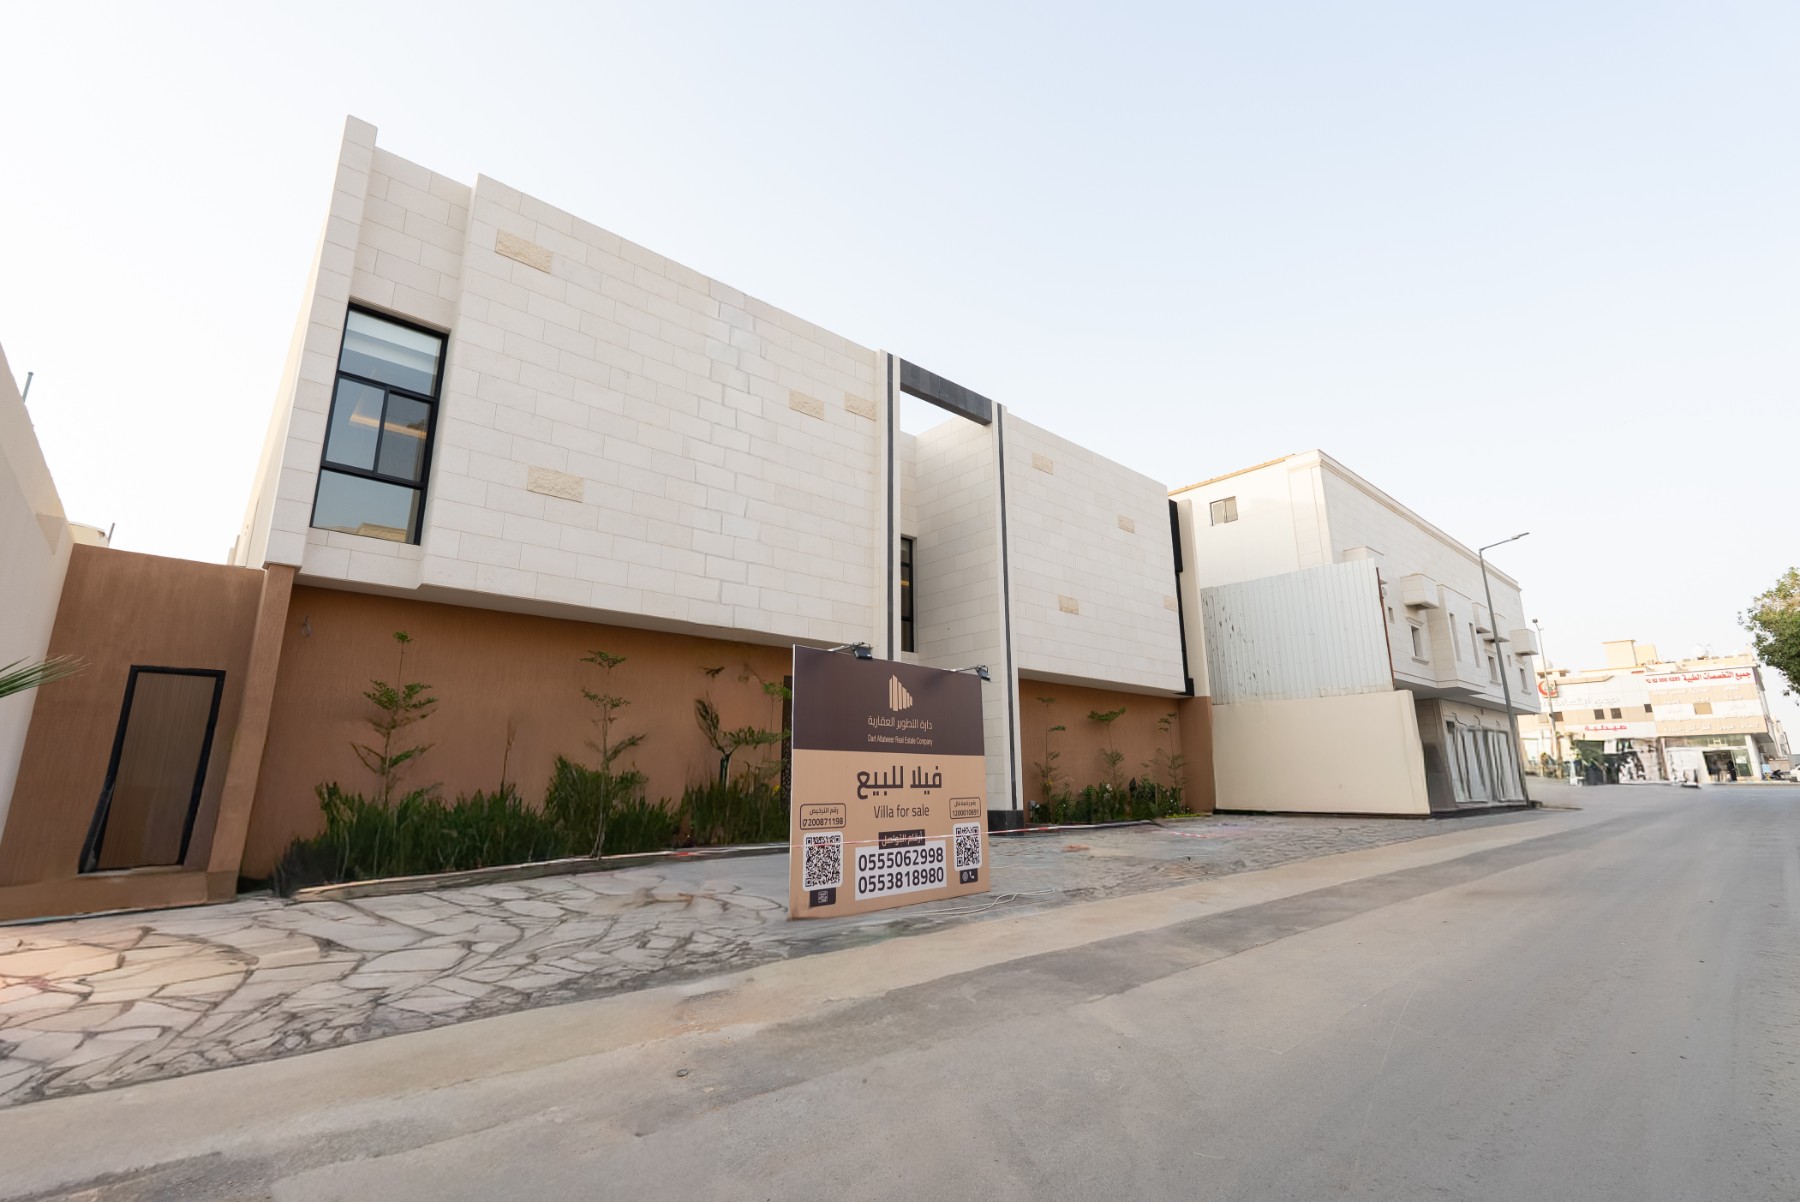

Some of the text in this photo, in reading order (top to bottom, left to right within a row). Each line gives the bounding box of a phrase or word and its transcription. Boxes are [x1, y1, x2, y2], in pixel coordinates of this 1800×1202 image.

[1682, 674, 1702, 683] الطبية
[1703, 671, 1734, 680] التخصصات
[1735, 670, 1751, 681] جميع
[867, 715, 933, 732] دارة التطوير العقارية
[905, 736, 916, 745] Estate
[917, 737, 933, 747] Company
[857, 765, 942, 800] فيلا للبيع
[809, 806, 839, 816] رقم الترخيص
[873, 804, 930, 819] Villa for sale
[858, 846, 944, 872] 0555062998
[858, 866, 944, 894] 0553818980
